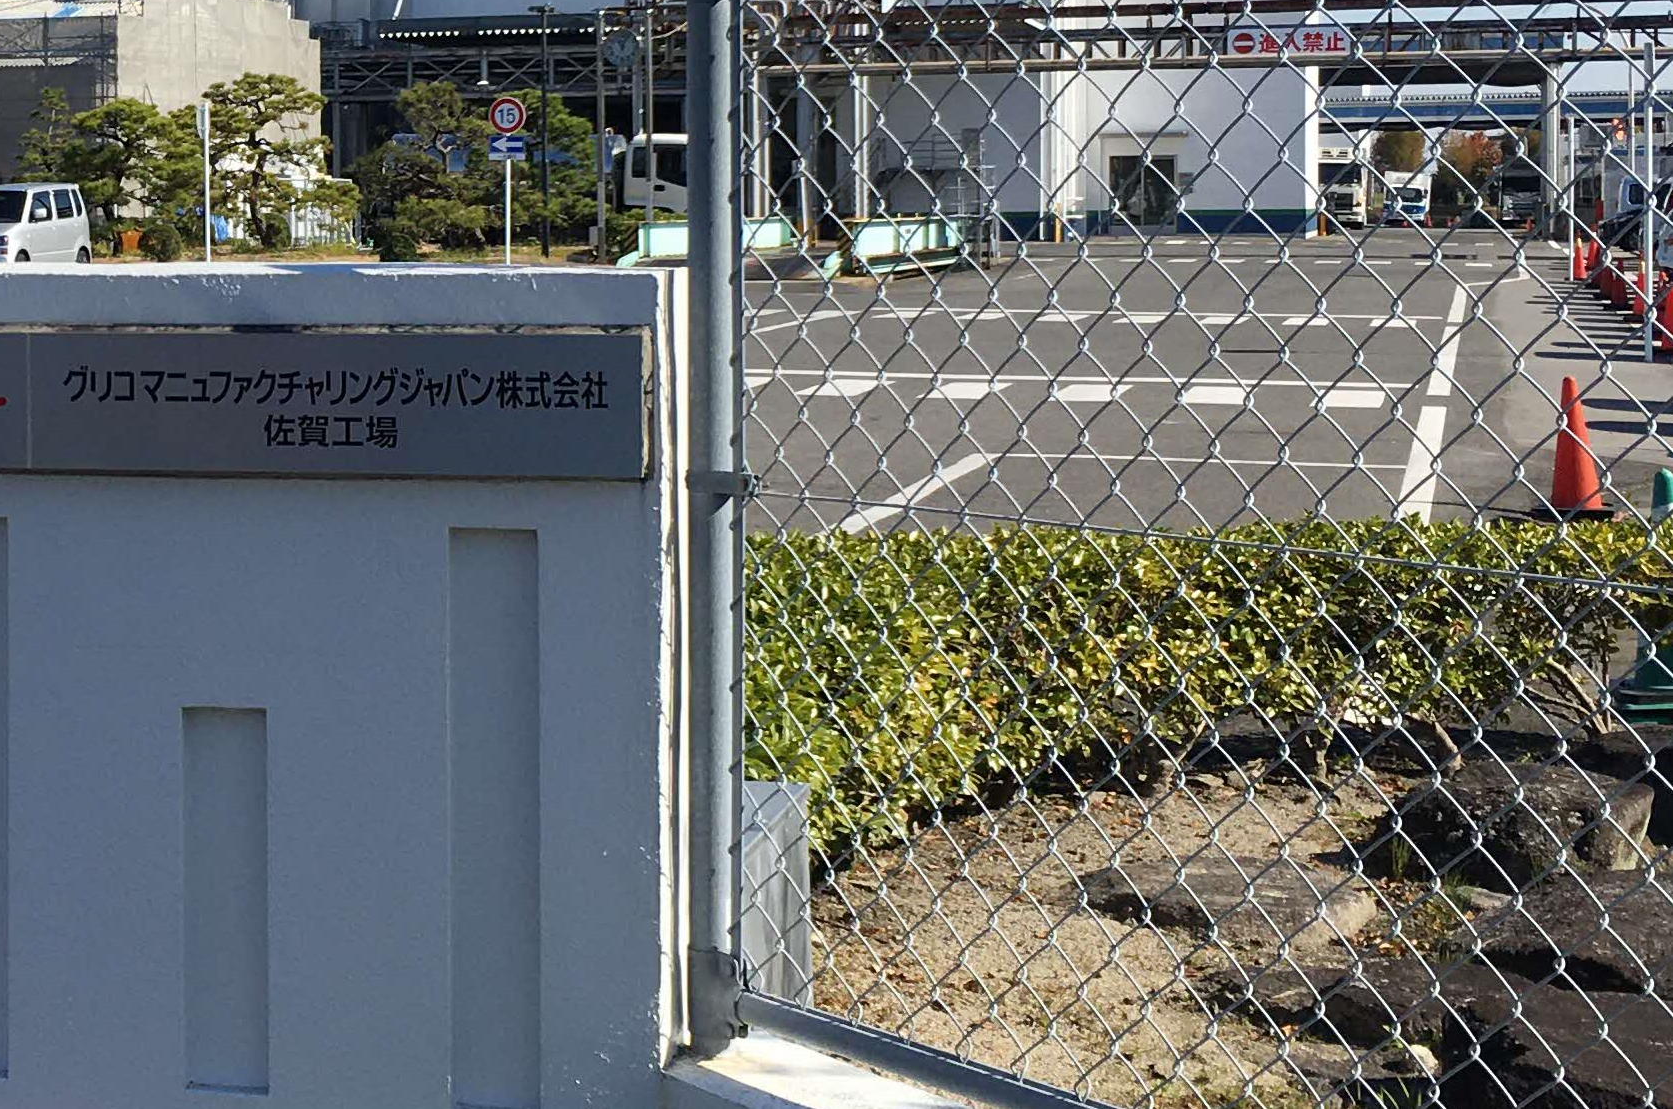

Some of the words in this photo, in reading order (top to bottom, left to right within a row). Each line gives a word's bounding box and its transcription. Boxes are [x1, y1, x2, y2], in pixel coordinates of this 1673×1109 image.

[497, 107, 516, 124] 15
[62, 367, 609, 410] グリコマニュファクチャリングジャパン株式会社
[263, 412, 399, 450] 佐賀工場
